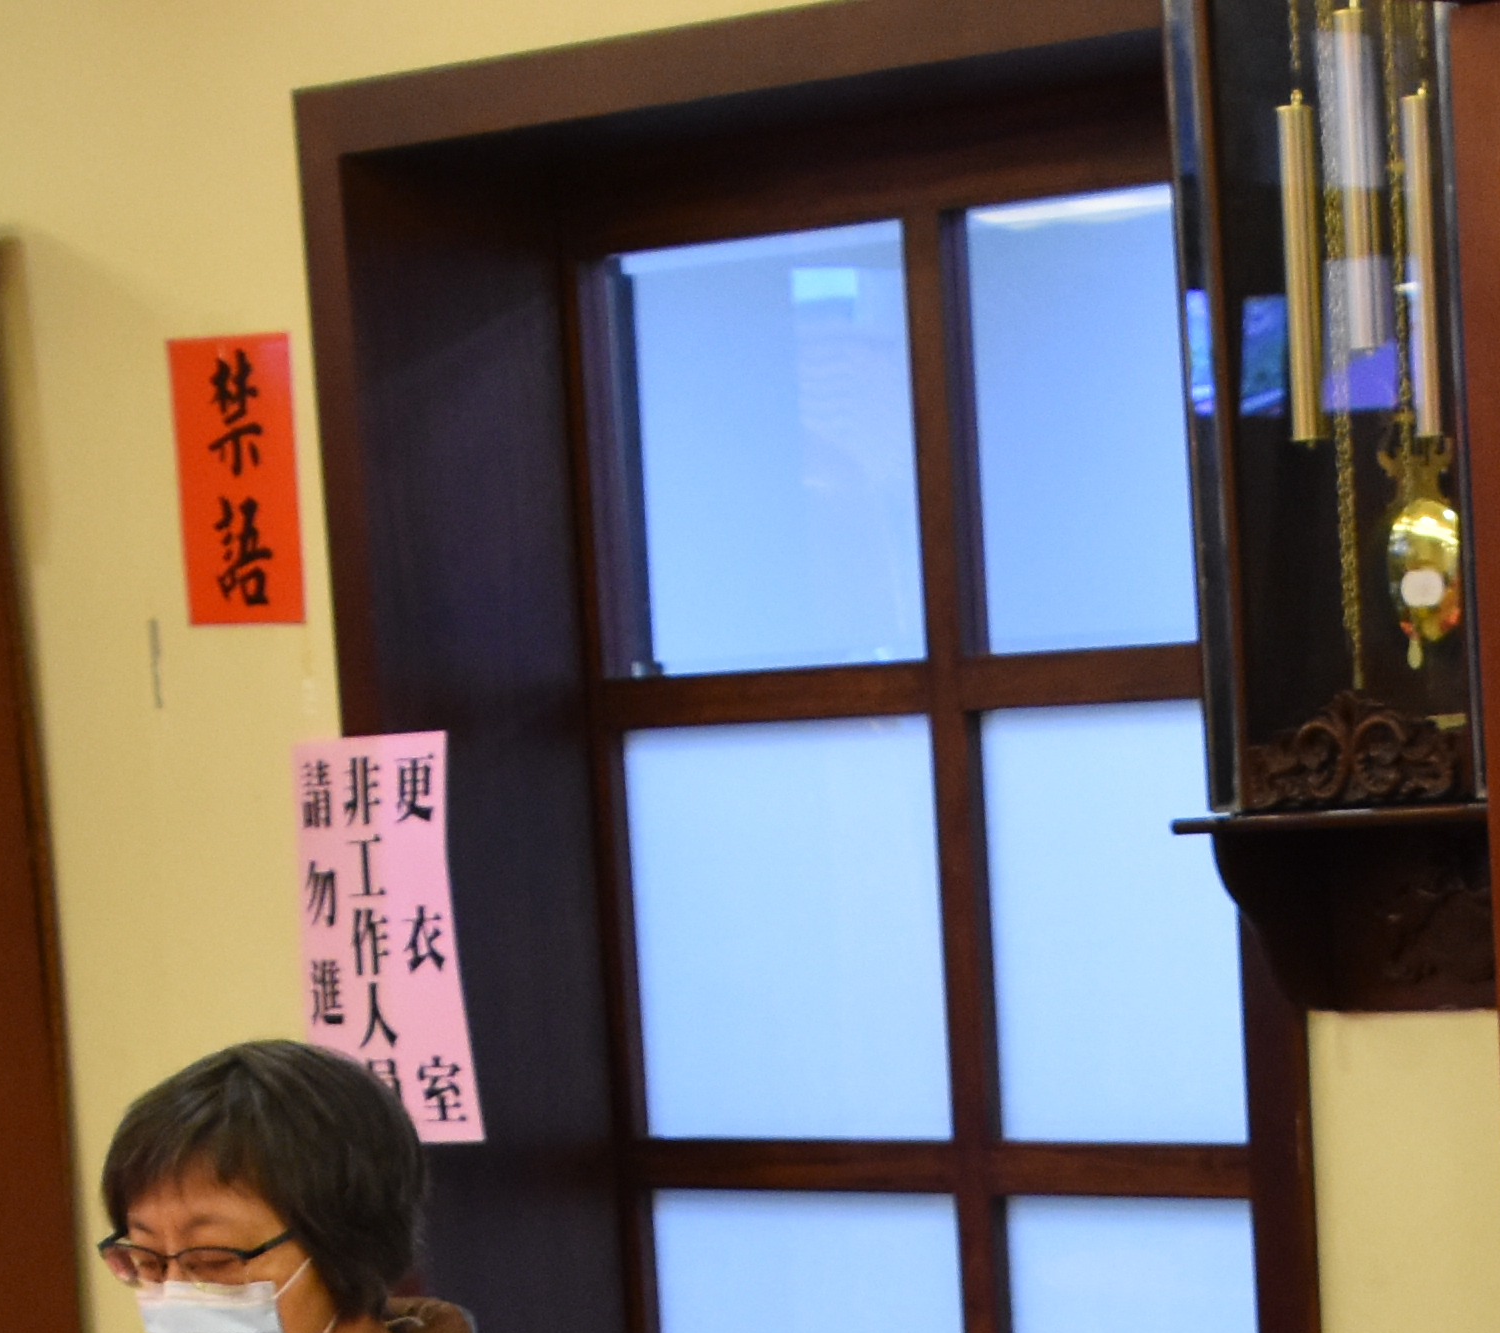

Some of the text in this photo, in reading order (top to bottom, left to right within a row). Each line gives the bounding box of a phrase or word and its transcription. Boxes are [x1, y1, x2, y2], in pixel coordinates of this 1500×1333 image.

[208, 348, 273, 606] 禁語
[394, 753, 468, 1123] 更衣室
